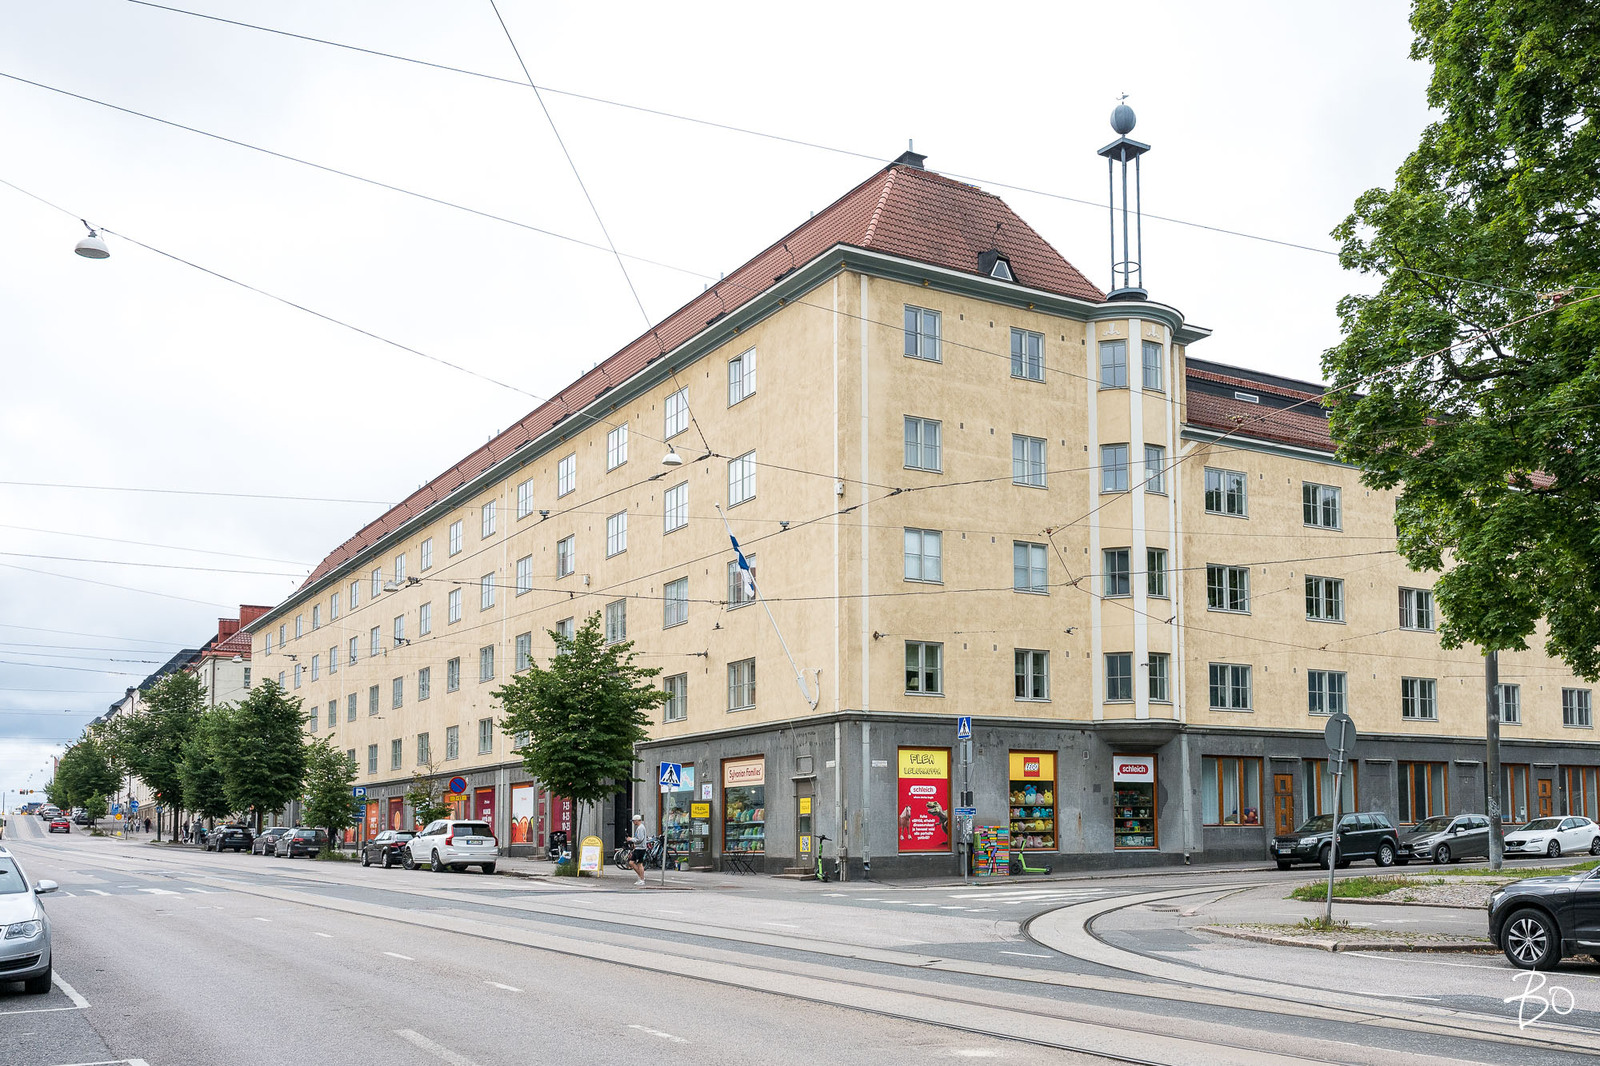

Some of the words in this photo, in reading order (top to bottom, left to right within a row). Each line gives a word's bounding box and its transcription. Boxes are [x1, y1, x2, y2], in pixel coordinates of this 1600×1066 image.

[910, 754, 935, 764] FLEA
[1025, 762, 1040, 771] LEGO
[1122, 765, 1146, 773] schleich
